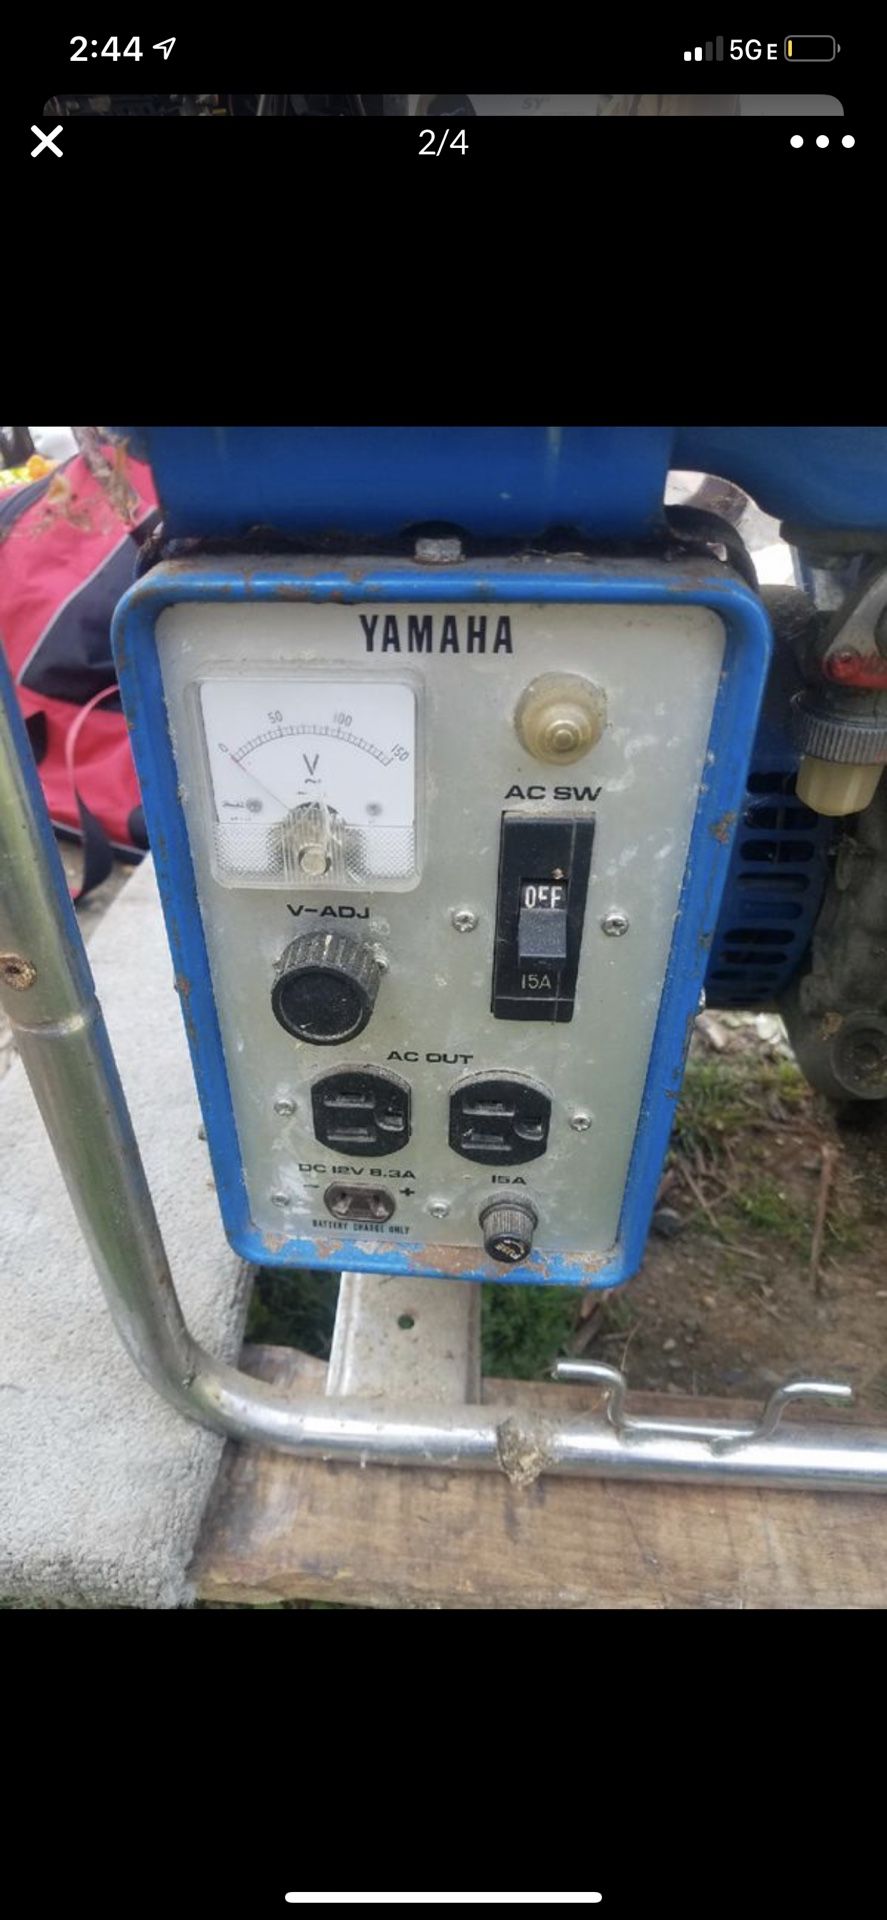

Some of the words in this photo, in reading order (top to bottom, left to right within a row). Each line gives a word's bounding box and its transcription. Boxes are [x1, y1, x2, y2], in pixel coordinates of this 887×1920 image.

[359, 614, 513, 654] YAMAHA
[267, 709, 283, 724] 50
[333, 712, 353, 727] 100
[217, 743, 229, 753] 0
[390, 743, 410, 762] 150
[302, 753, 320, 776] V
[504, 784, 546, 800] AC
[553, 786, 602, 801] SW
[525, 885, 563, 908] OFF
[287, 903, 370, 919] V-ADJ
[521, 973, 552, 989] 15A
[387, 1050, 419, 1062] AC
[426, 1052, 474, 1064] OUT
[298, 1163, 327, 1174] DC
[332, 1165, 365, 1176] 12V
[370, 1168, 416, 1179] 8.3A
[491, 1174, 527, 1185] 15A
